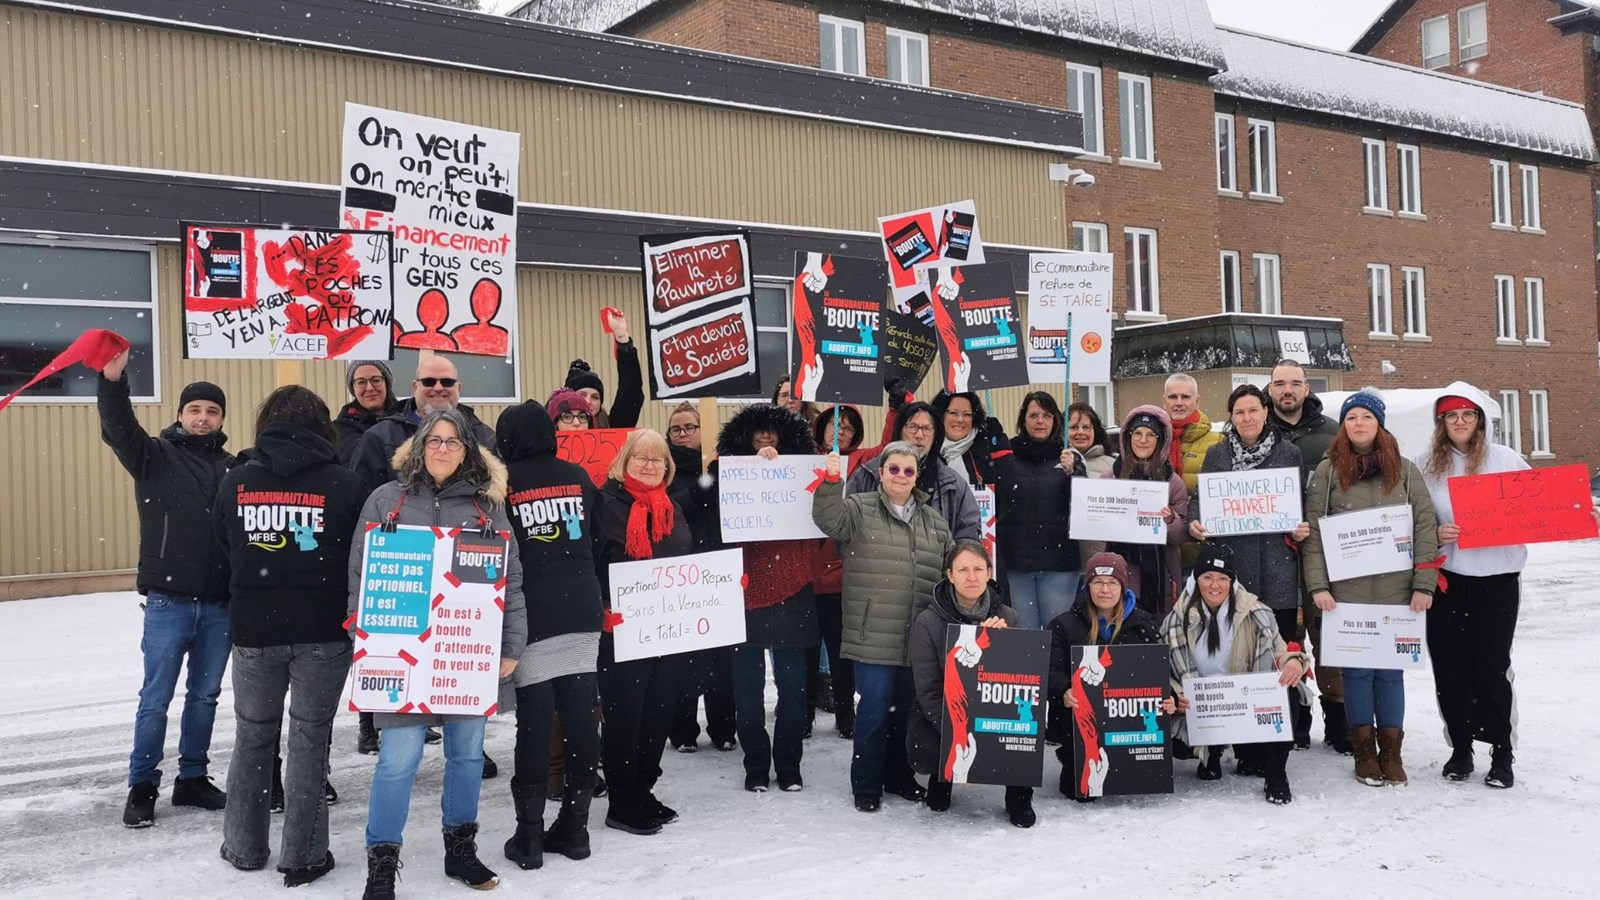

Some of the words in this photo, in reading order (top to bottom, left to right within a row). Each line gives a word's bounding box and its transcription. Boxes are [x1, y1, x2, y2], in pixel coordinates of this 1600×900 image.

[358, 117, 402, 150] On
[400, 156, 432, 176] on
[350, 162, 384, 189] On
[396, 177, 471, 207] mérite
[429, 203, 495, 230] mieux
[365, 211, 511, 256] Financement
[299, 257, 339, 276] LES
[419, 247, 461, 270] tous
[470, 257, 503, 275] ces
[655, 243, 731, 275] Eliminer
[1031, 257, 1046, 273] Le
[406, 267, 458, 289] GENS
[687, 264, 705, 280] la
[305, 275, 383, 294] POCHES
[656, 266, 737, 307] Pauvreté
[1040, 278, 1075, 290] refuse
[1079, 278, 1093, 288] de
[327, 293, 353, 304] DU
[823, 298, 880, 311] COMMUNAUTAIRE
[960, 297, 1011, 310] COMMUNAUTAIRE
[1040, 295, 1056, 307] SE
[212, 307, 236, 327] DE
[827, 308, 880, 331] BOUTTE
[965, 306, 1013, 327] BOUTTE
[700, 319, 744, 344] devoir
[281, 338, 326, 352] ACEF
[828, 343, 872, 355] ABOUTTE.INFO
[970, 337, 1010, 347] ABOUTTE.INFO
[1284, 342, 1305, 353] CLSC
[666, 361, 685, 377] de
[686, 338, 748, 377] Société
[721, 468, 758, 481] APPELS
[762, 465, 797, 480] DONNÉS
[237, 484, 245, 492] LE
[1207, 476, 1270, 498] ELIMINER
[1276, 476, 1294, 494] LA
[1497, 472, 1544, 499] 133
[237, 491, 326, 507] COMMUNAUTAIRE
[509, 484, 583, 505] COMMUNAUTAIRE
[721, 492, 755, 505] APPELS
[243, 504, 325, 533] BOUTTE
[518, 496, 585, 528] BOUTTE
[722, 515, 773, 529] ACCUEILS
[1234, 515, 1265, 532] DEVOIR
[248, 532, 277, 542] MFBE
[527, 524, 553, 536] MFBE
[372, 534, 386, 546] Le
[370, 551, 432, 562] communautaire
[459, 552, 503, 568] BOUTTE
[369, 562, 400, 574] n'est
[402, 564, 424, 577] pas
[367, 578, 428, 596] OPTIONNEL,
[618, 580, 658, 607] portions
[652, 564, 699, 588] 7550
[701, 569, 733, 589] Repas
[365, 597, 374, 608] Il
[377, 597, 397, 610] est
[627, 605, 656, 618] Sans
[662, 595, 676, 613] La
[437, 607, 450, 619] On
[454, 608, 471, 620] est
[475, 607, 482, 619] à
[364, 614, 419, 629] ESSENTIEL
[435, 624, 472, 636] boutte
[639, 628, 651, 644] Le
[697, 618, 709, 635] 0
[434, 642, 495, 656] d'attendre,
[1396, 643, 1421, 654] BOUTTE
[359, 669, 406, 677] COMMUNAUTAIRE
[433, 659, 446, 670] On
[450, 660, 474, 671] veut
[477, 661, 490, 672] se
[361, 677, 405, 691] BOUTTE
[431, 676, 458, 688] faire
[977, 672, 1041, 685] COMMUNAUTAIRE
[1204, 680, 1235, 690] animations
[430, 694, 480, 706] entendre
[981, 683, 1040, 706] BOUTTE
[1103, 687, 1163, 698] COMMUNAUTAIRE
[1108, 697, 1163, 718] BOUTTE
[1257, 712, 1284, 725] BOUTTE
[981, 721, 1031, 732] ABOUTTE.INFO
[1111, 734, 1157, 743] ABOUTTE.INFO
